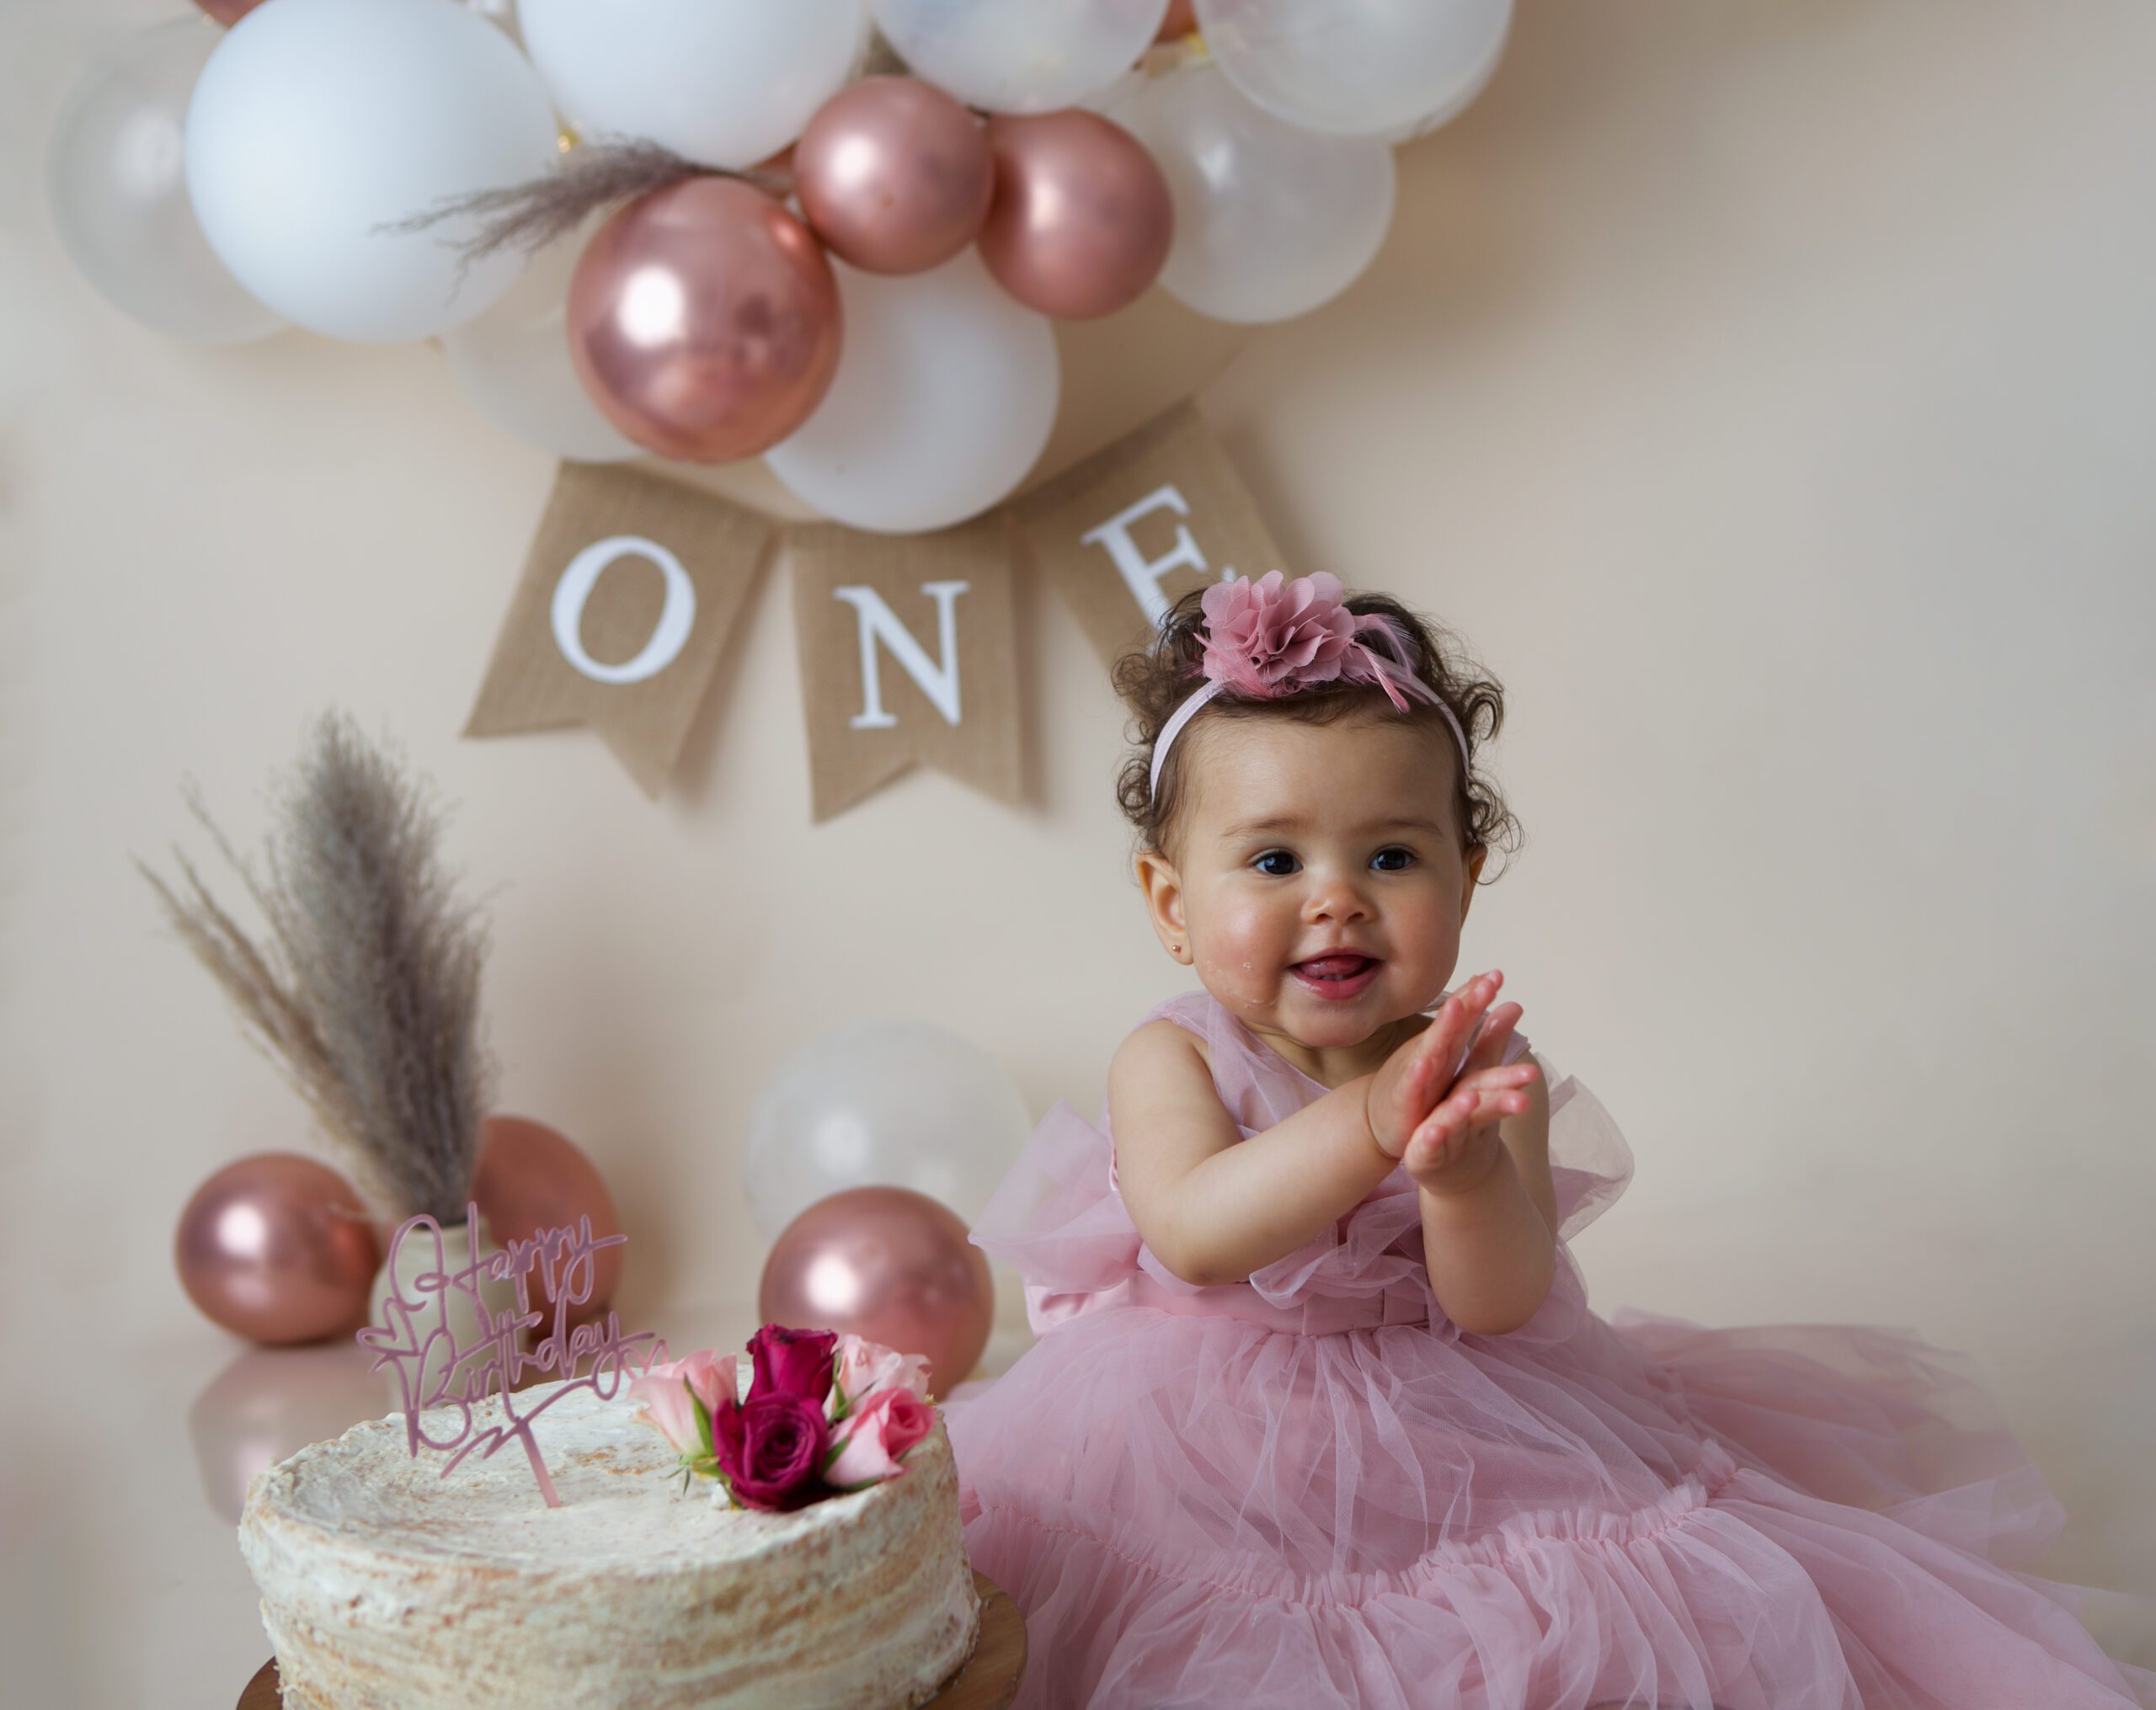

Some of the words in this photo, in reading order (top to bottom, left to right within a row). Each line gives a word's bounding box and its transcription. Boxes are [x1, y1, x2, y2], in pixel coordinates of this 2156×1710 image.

[551, 484, 1235, 729] ONE
[388, 1201, 627, 1330] Happy
[368, 1309, 655, 1478] Birthday
